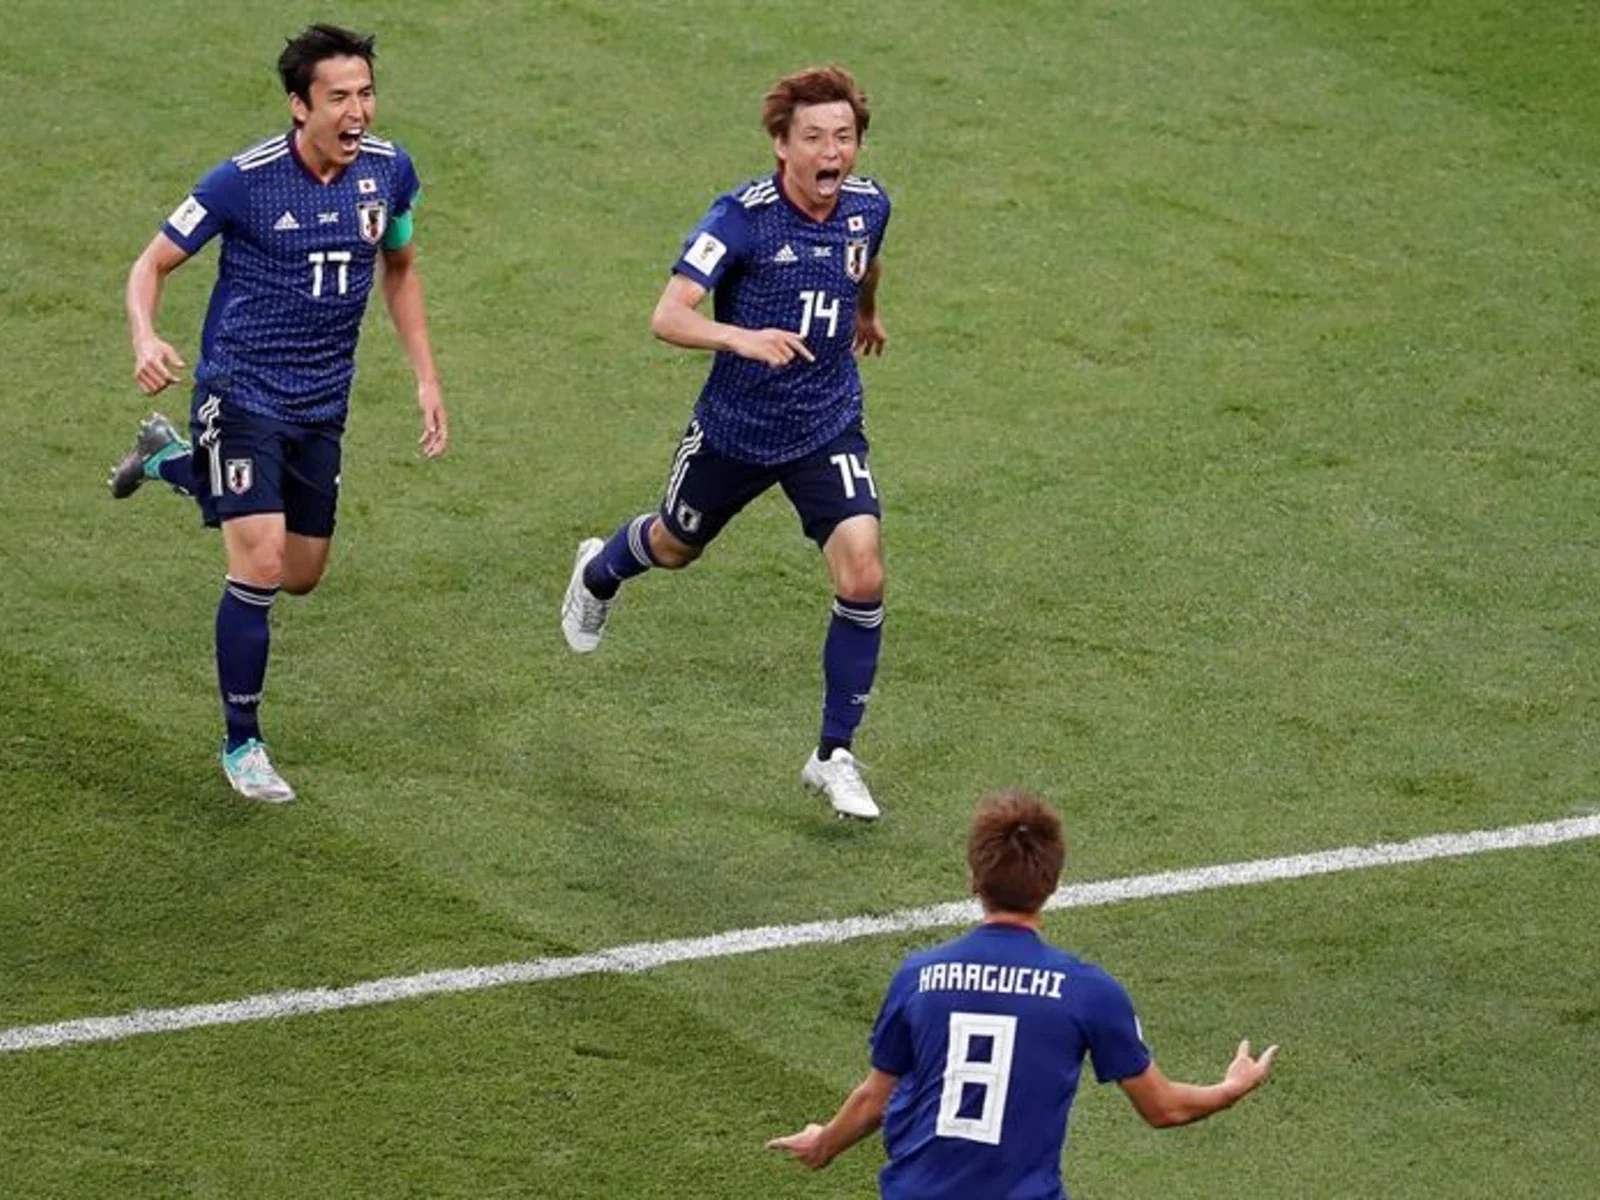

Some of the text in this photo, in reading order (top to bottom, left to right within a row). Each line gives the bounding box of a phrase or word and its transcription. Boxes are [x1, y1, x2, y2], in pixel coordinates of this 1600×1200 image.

[308, 251, 351, 297] 17
[799, 290, 840, 339] 14
[829, 453, 878, 499] 14
[919, 962, 1066, 999] HARAGUCHI
[936, 1012, 1018, 1145] 8
